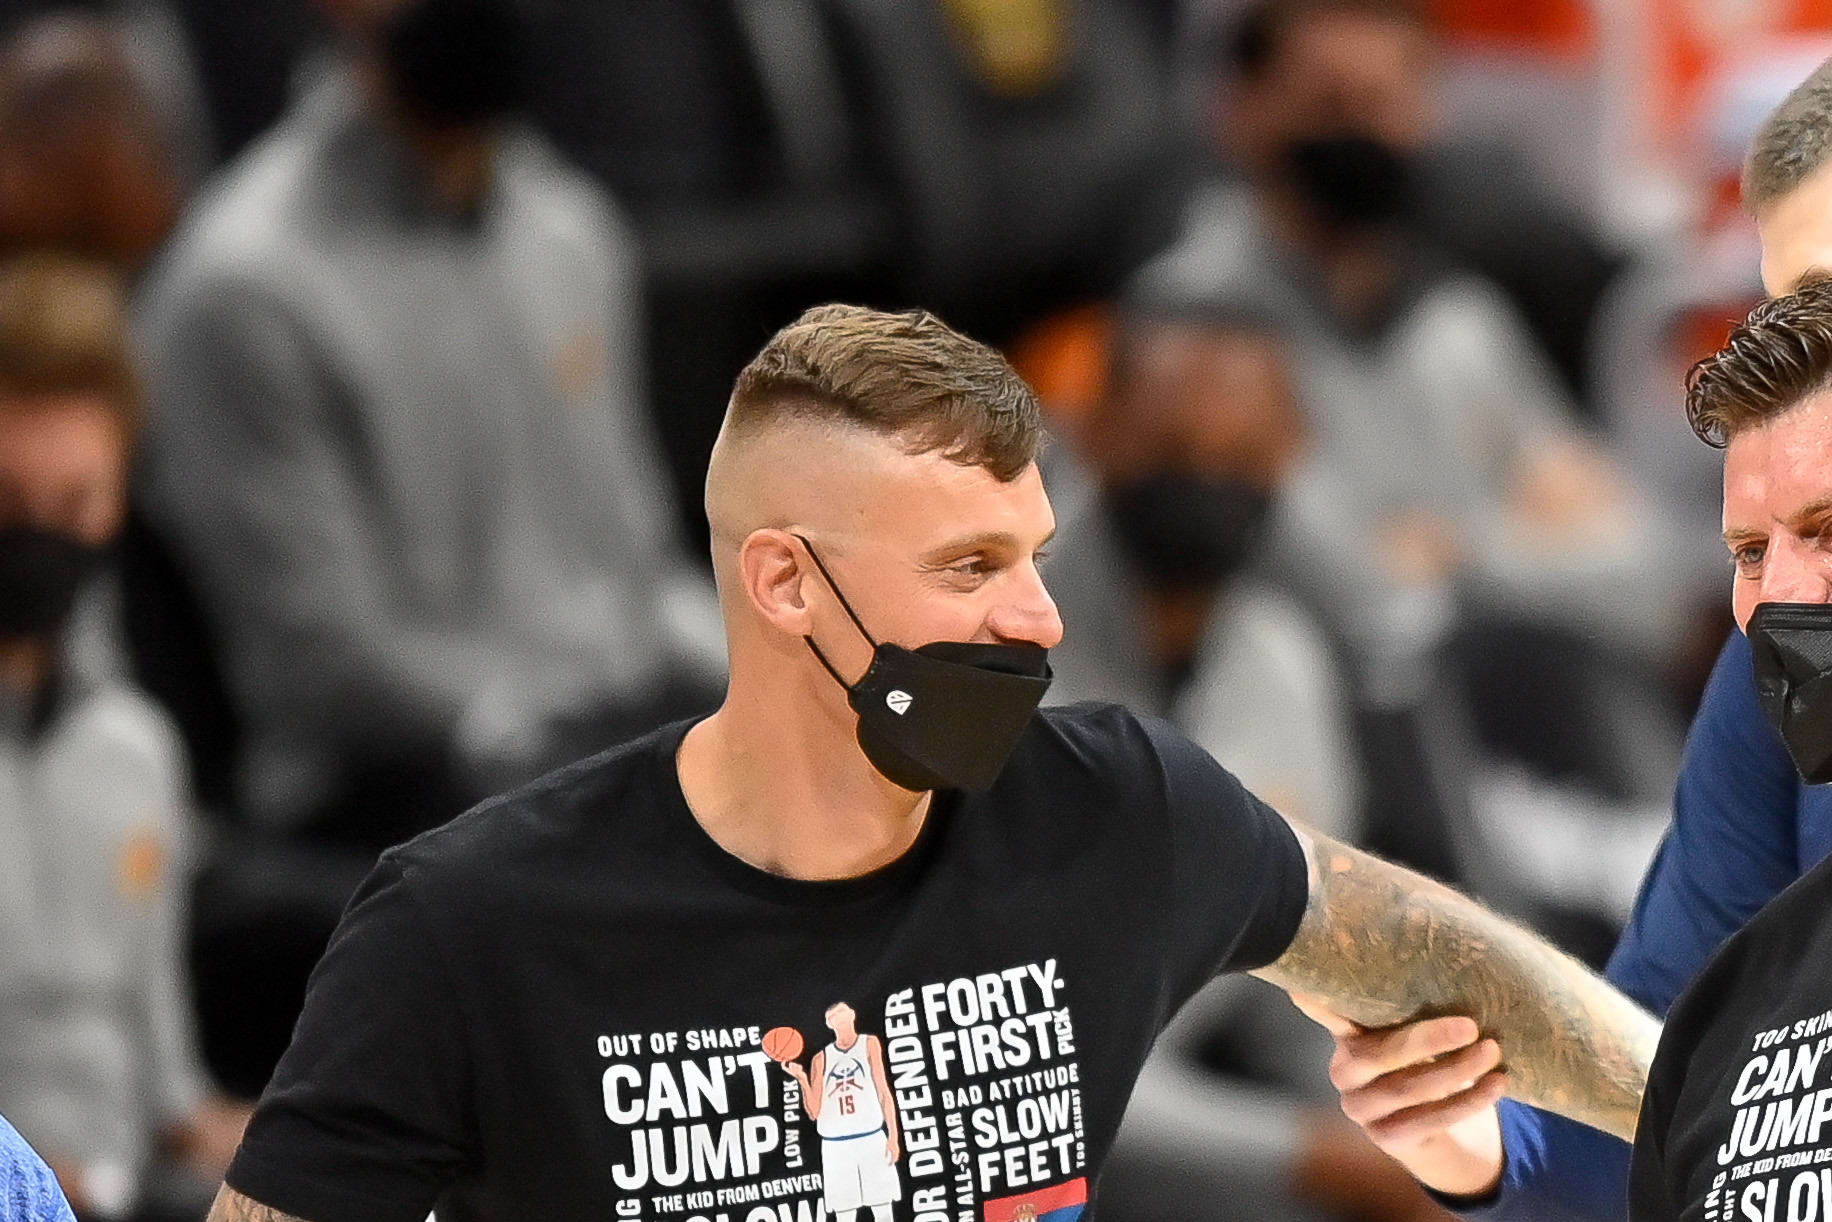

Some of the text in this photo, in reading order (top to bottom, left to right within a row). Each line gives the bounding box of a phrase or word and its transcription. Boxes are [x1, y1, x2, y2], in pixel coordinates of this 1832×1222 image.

[597, 1026, 761, 1057] OUT OF SHAPE
[930, 1010, 1053, 1081] FIRST
[1052, 1006, 1076, 1056] PICK
[1751, 1025, 1790, 1051] TOO
[602, 1051, 772, 1125] CAN'T
[838, 1094, 856, 1116] 15
[885, 987, 944, 1177] DEFENDER
[941, 1062, 1080, 1110] BAD ATTITUDE
[783, 1079, 803, 1168] LOW PICK
[971, 1089, 1070, 1148] SLOW
[611, 1115, 779, 1190] JUMP
[945, 1112, 974, 1205] ALL-STAR
[977, 1133, 1075, 1193] FEET
[1731, 1162, 1753, 1181] THE
[1751, 1157, 1775, 1175] KID
[1774, 1151, 1813, 1170] FROM
[651, 1173, 823, 1214] THE KID FROM DENVER
